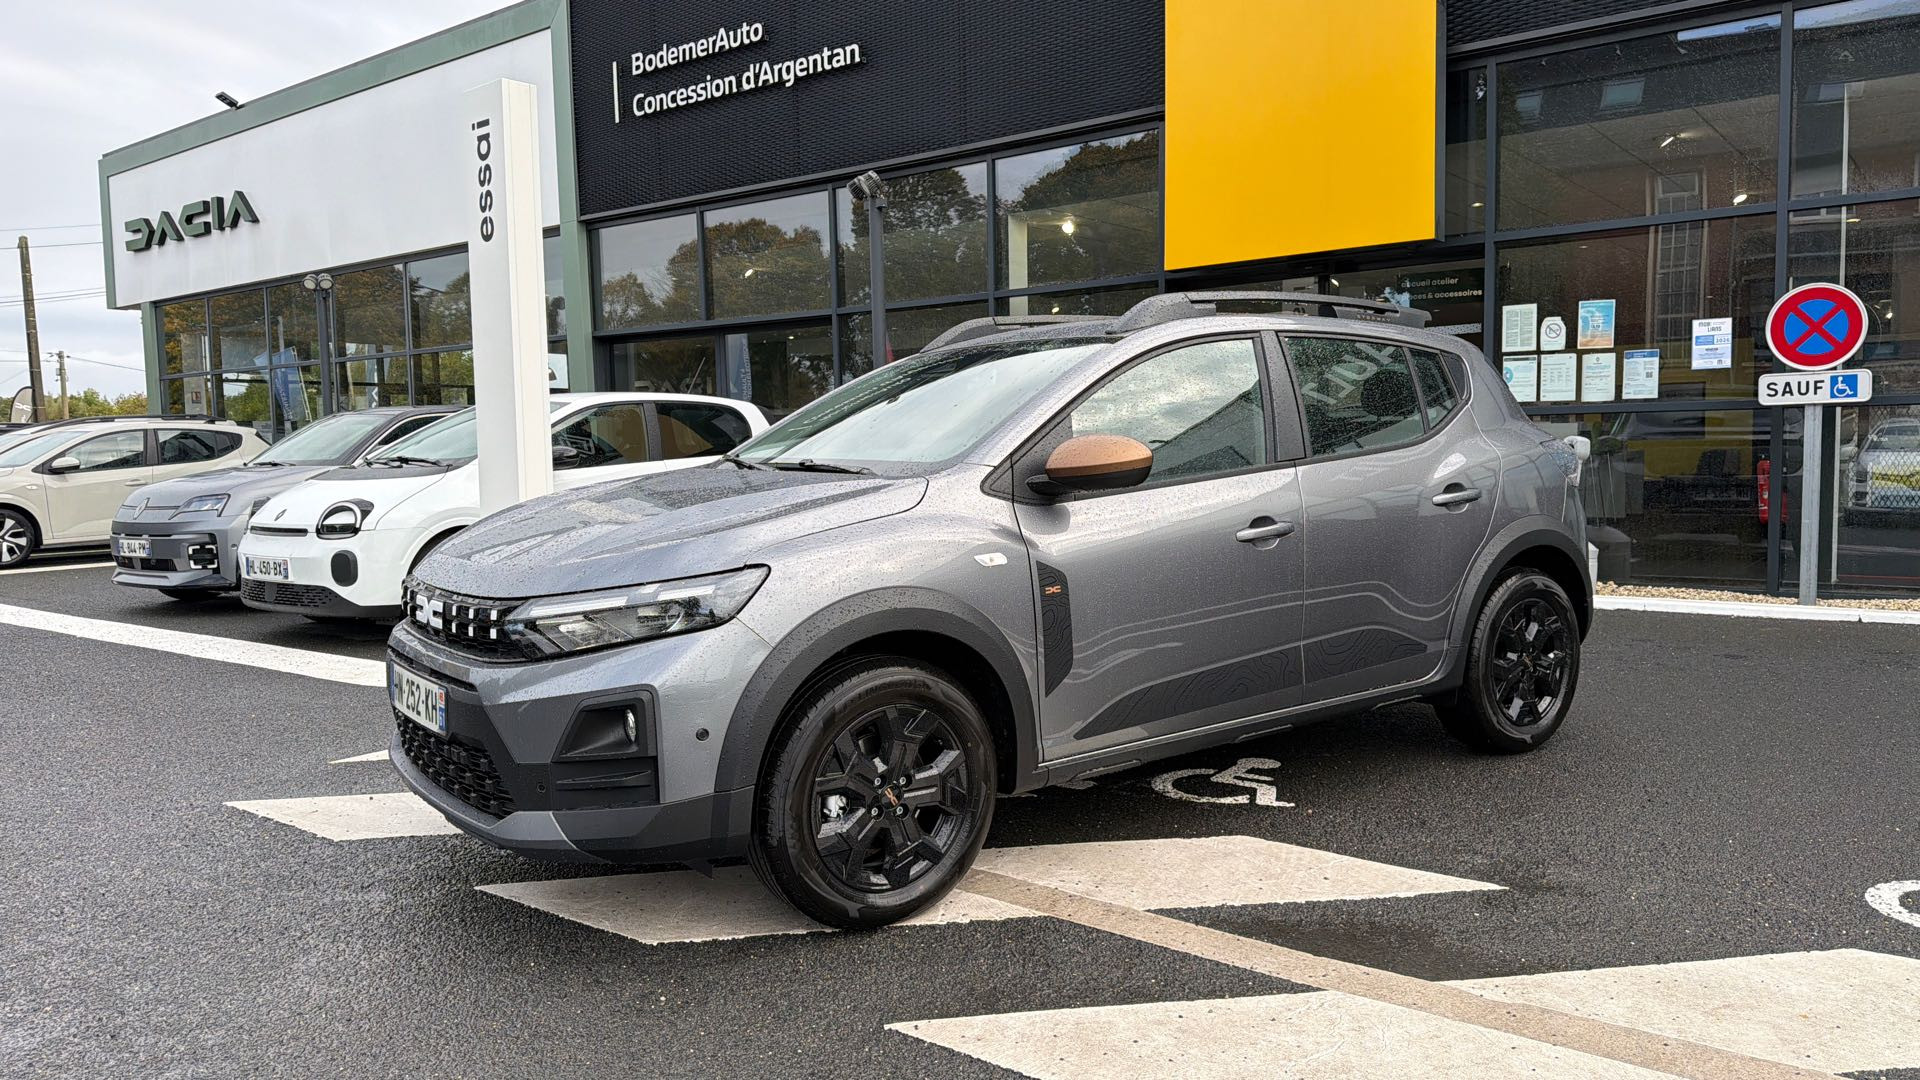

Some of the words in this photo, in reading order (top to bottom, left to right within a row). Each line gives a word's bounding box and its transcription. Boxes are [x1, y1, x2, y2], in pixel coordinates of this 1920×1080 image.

[631, 21, 763, 75] BodemerAuto
[632, 74, 737, 116] Concession
[742, 42, 861, 87] d'Argentan
[472, 118, 495, 242] essai
[124, 190, 260, 252] DACIA
[1431, 277, 1459, 286] atelier
[1434, 289, 1483, 299] accessoires
[1766, 379, 1825, 397] SAUF
[249, 559, 283, 577] HL-450-BX
